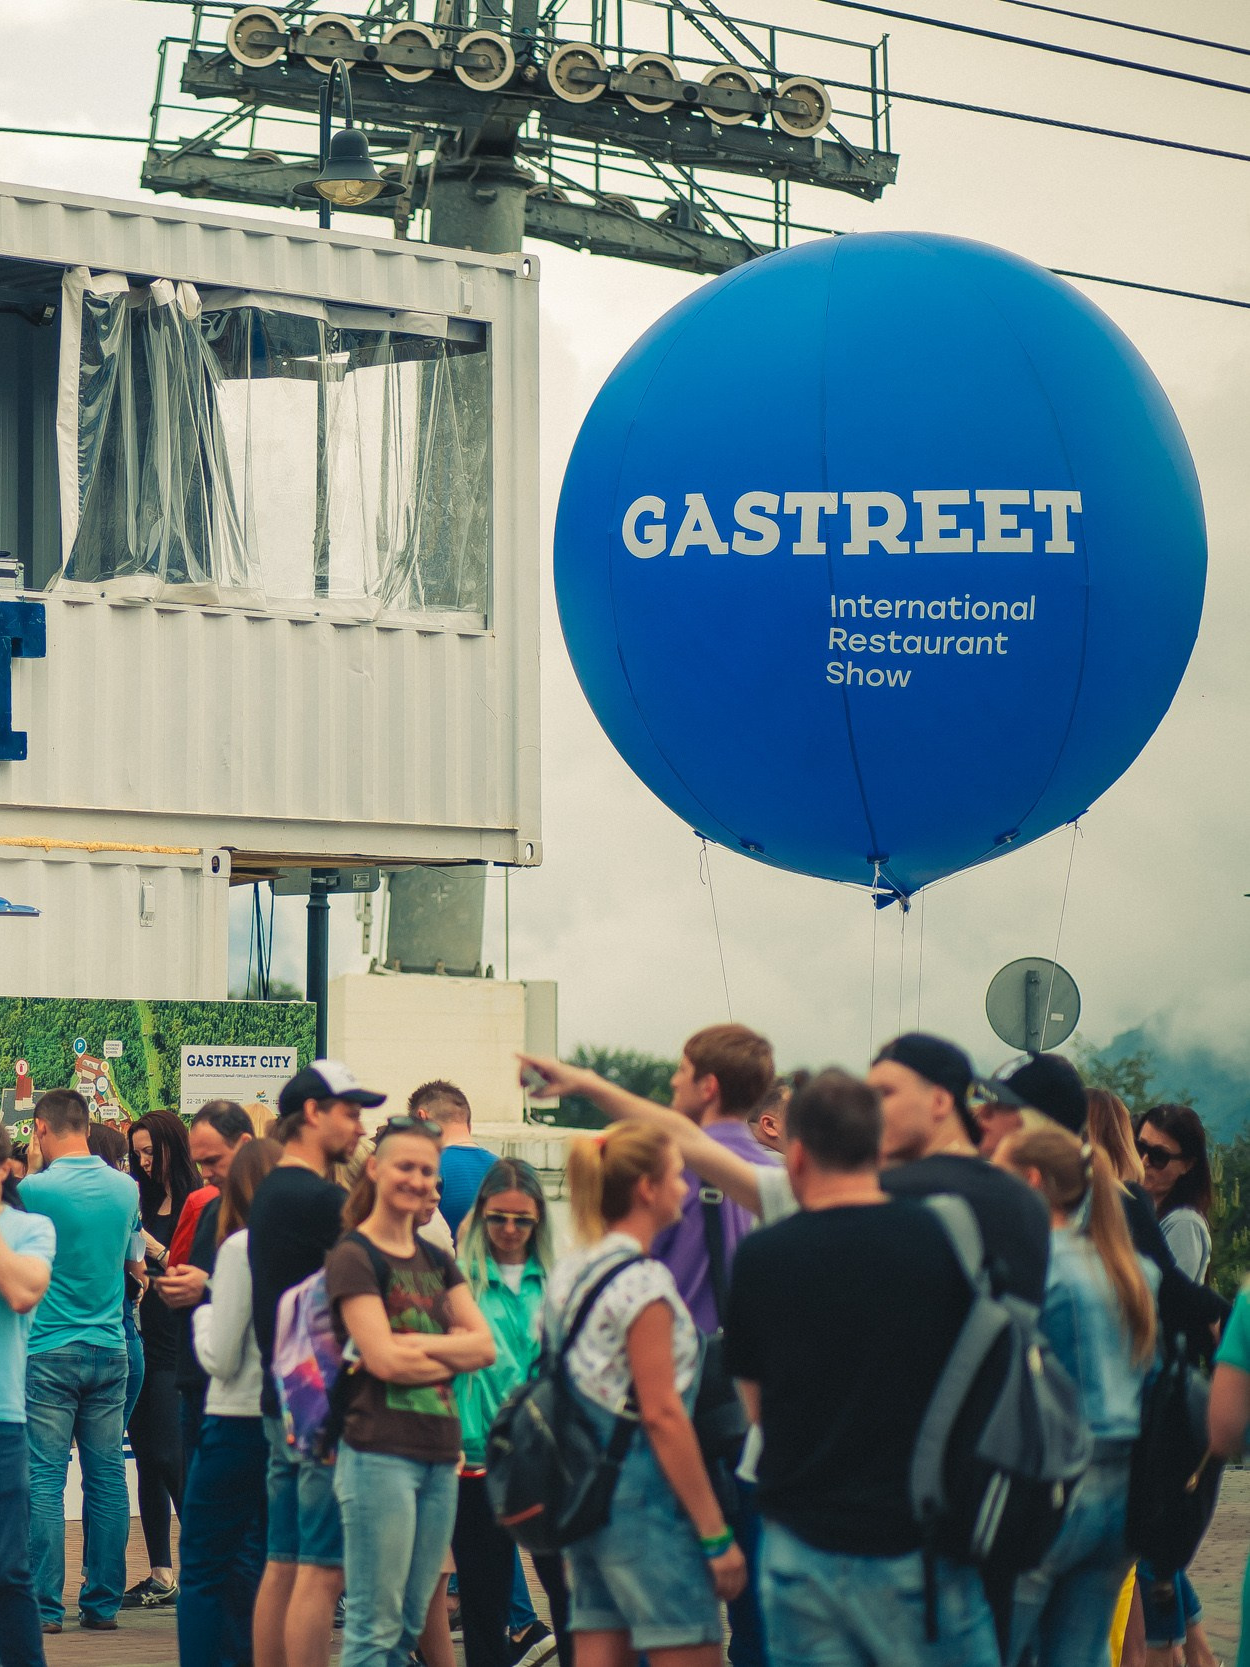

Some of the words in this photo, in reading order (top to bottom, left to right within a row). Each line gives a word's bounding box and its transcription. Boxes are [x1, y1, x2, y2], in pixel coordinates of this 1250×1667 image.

[622, 489, 1083, 559] GASTREET
[830, 593, 1036, 621] International
[828, 627, 1009, 655] Restaurant
[825, 661, 912, 688] Show
[186, 1055, 257, 1068] GASTREET
[260, 1056, 291, 1068] CITY
